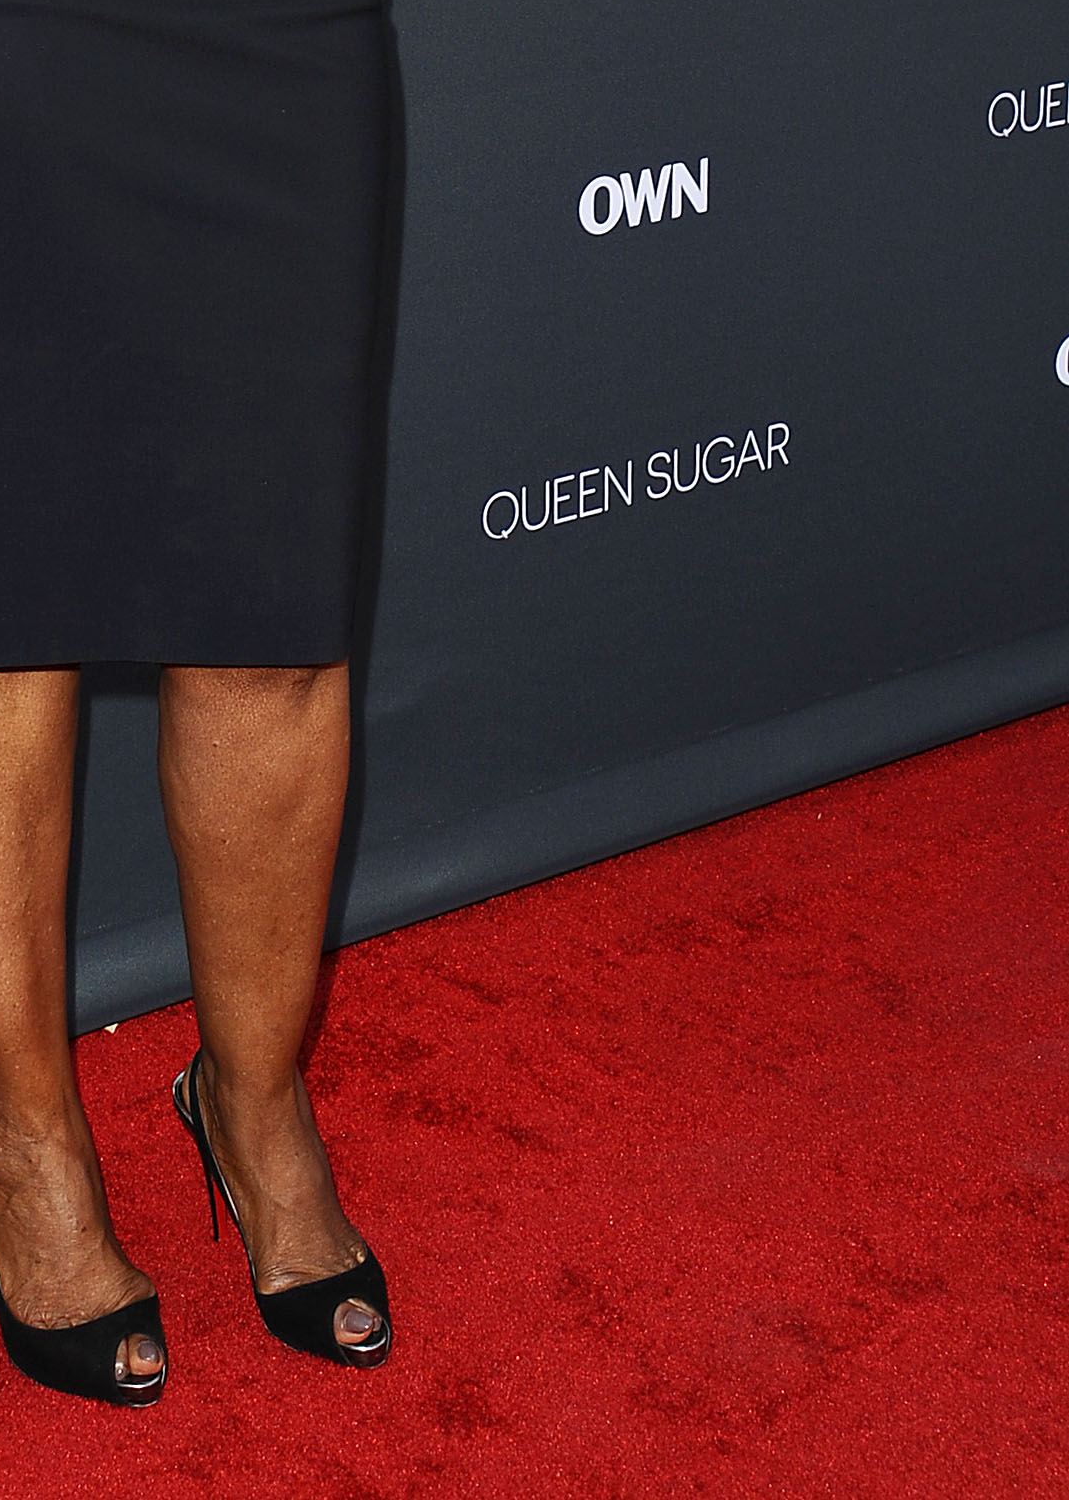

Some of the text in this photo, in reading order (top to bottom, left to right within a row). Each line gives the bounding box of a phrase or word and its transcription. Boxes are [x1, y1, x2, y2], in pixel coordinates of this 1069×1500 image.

[988, 81, 1069, 137] QUE
[578, 157, 709, 235] OWN
[482, 422, 790, 539] QUEEN SUGAR
